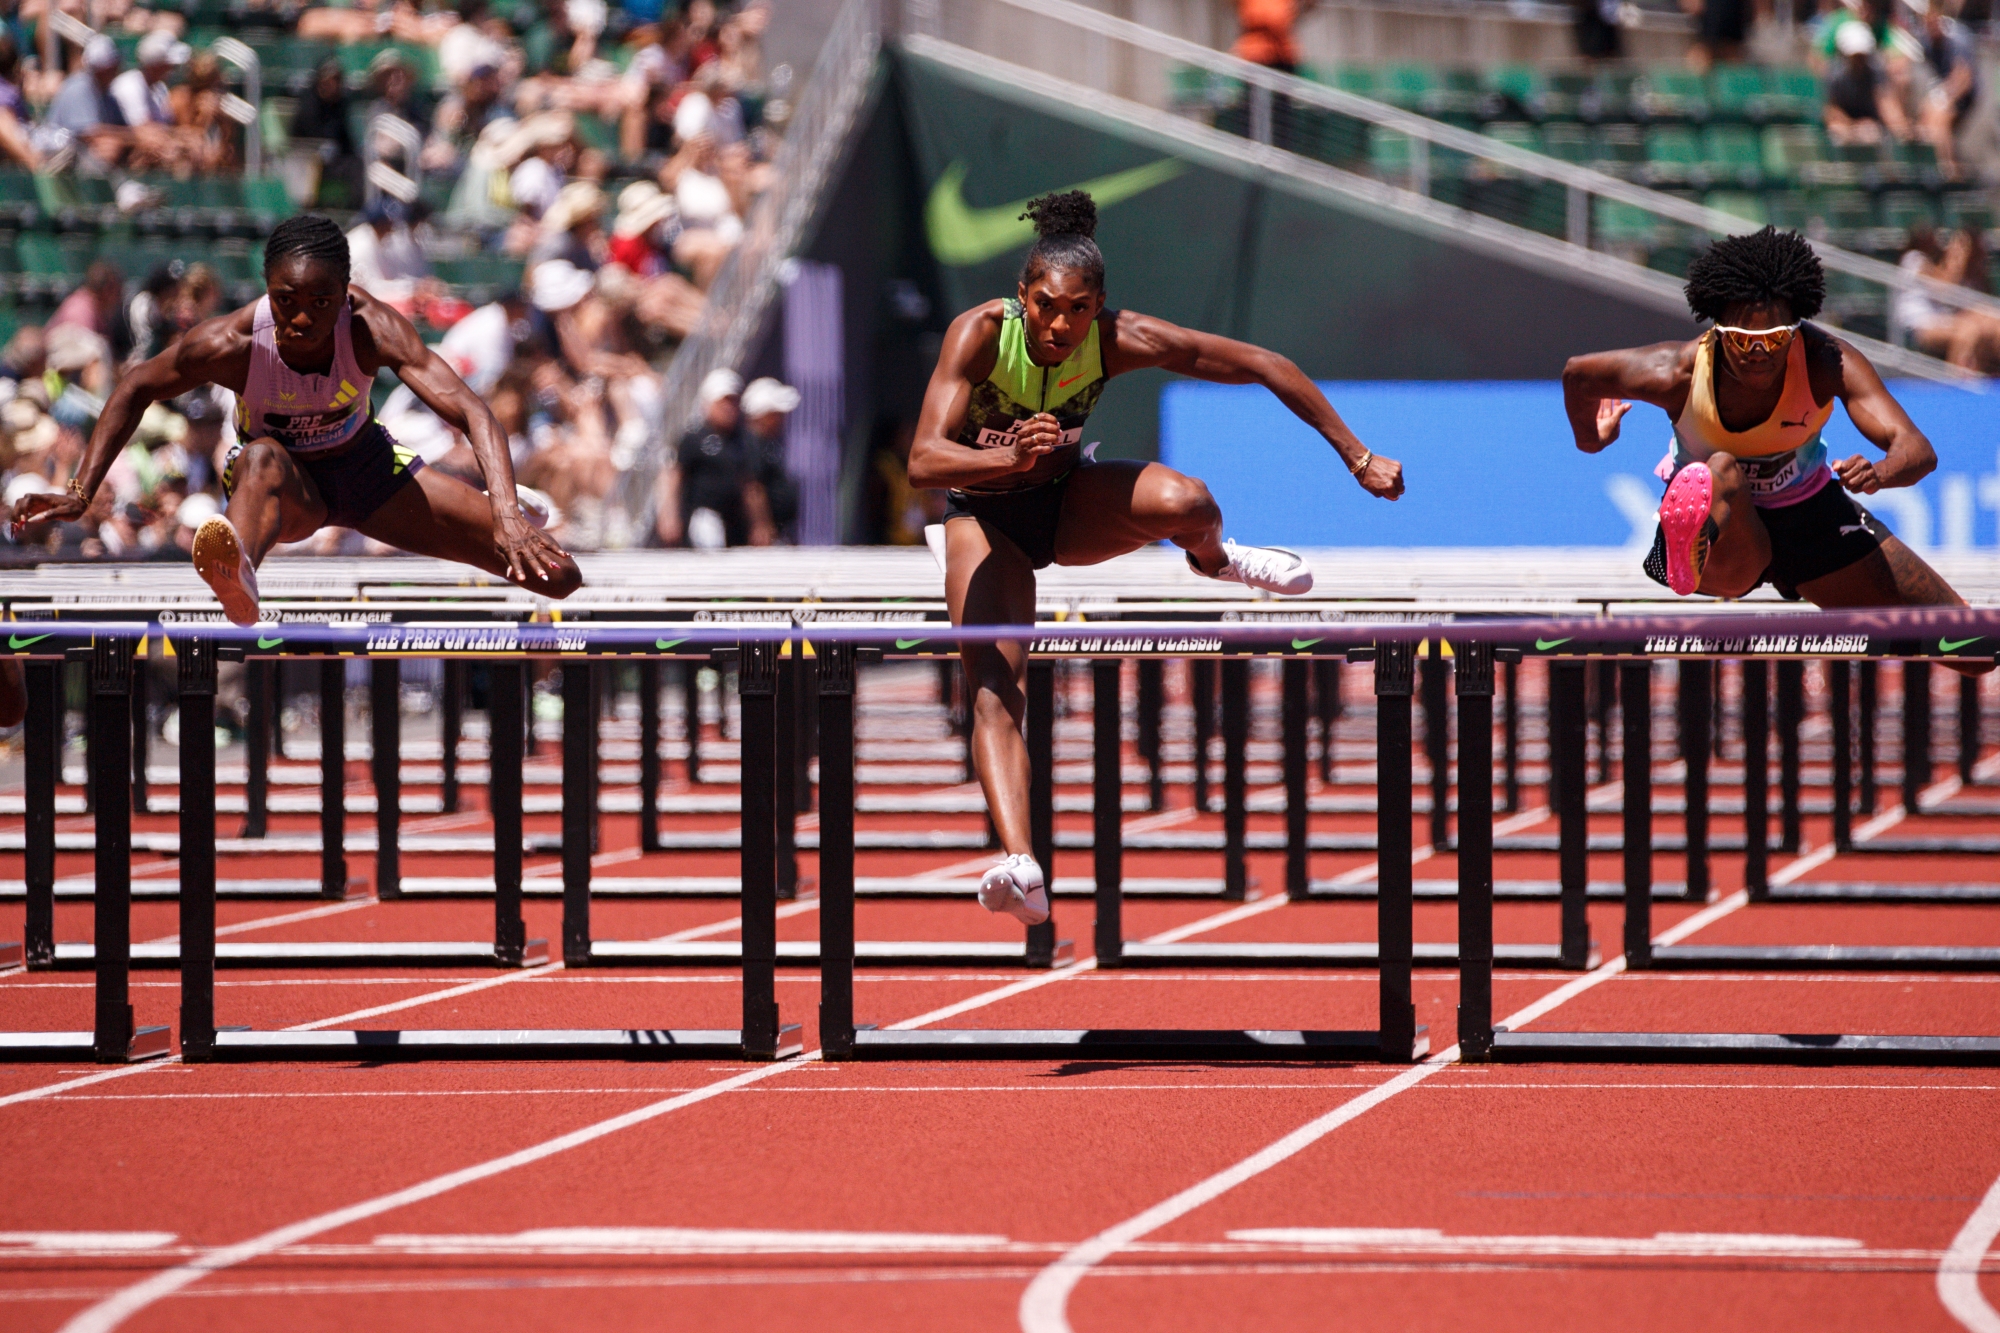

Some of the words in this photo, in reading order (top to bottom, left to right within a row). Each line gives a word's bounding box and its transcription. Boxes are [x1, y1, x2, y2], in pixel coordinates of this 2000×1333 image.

[286, 415, 324, 429] PRE
[295, 428, 345, 446] EUGENE
[282, 612, 342, 623] DIAMOND
[343, 612, 392, 623] LEAGUE
[816, 612, 875, 622] DIAMOND
[875, 612, 926, 622] LEAGUE
[366, 629, 401, 650] THE
[402, 629, 519, 650] PREFONTAINE
[521, 629, 588, 650] CLASSIC
[1038, 636, 1154, 651] PREFONTAINE
[1157, 636, 1222, 651] CLASSIC
[1644, 635, 1678, 652] THE
[1680, 635, 1799, 652] PREFONTAINE
[1801, 635, 1868, 652] CLASSIC
